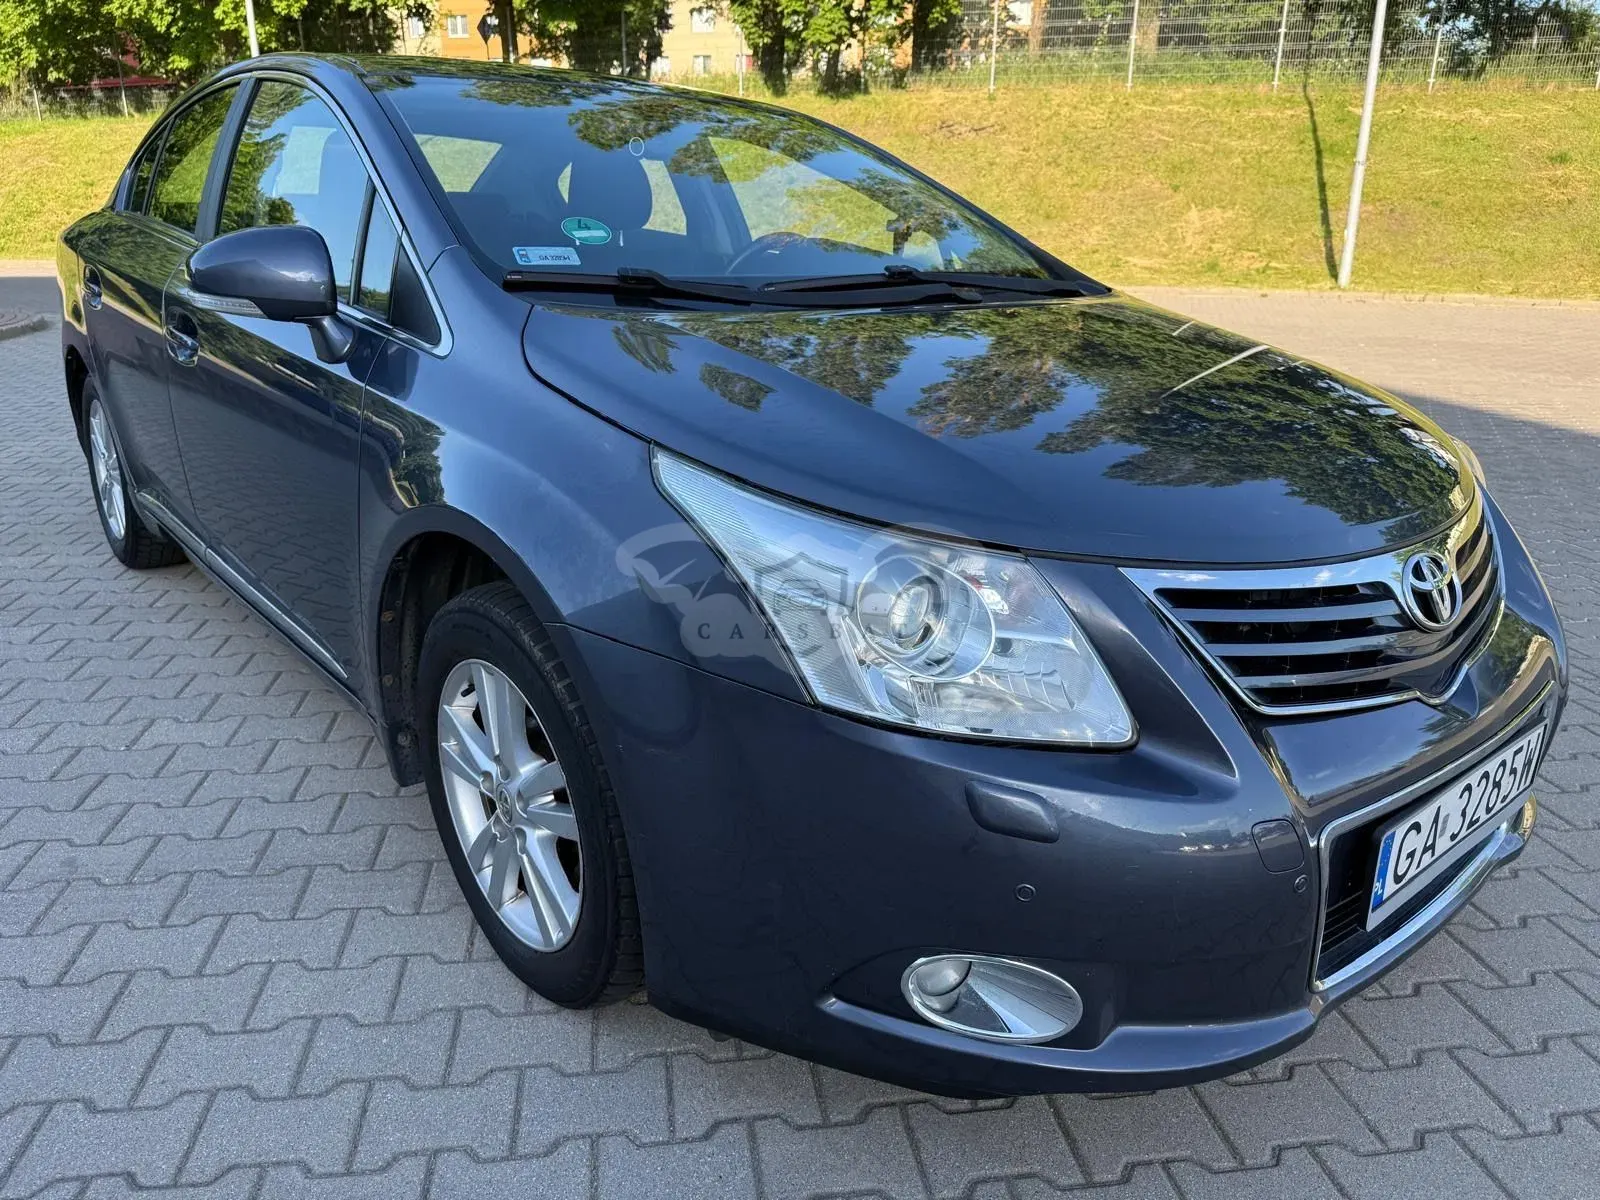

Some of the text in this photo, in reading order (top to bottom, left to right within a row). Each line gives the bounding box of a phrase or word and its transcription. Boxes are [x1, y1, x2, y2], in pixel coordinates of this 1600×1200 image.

[1393, 731, 1541, 886] GA 3285W
[1374, 878, 1383, 895] PL
